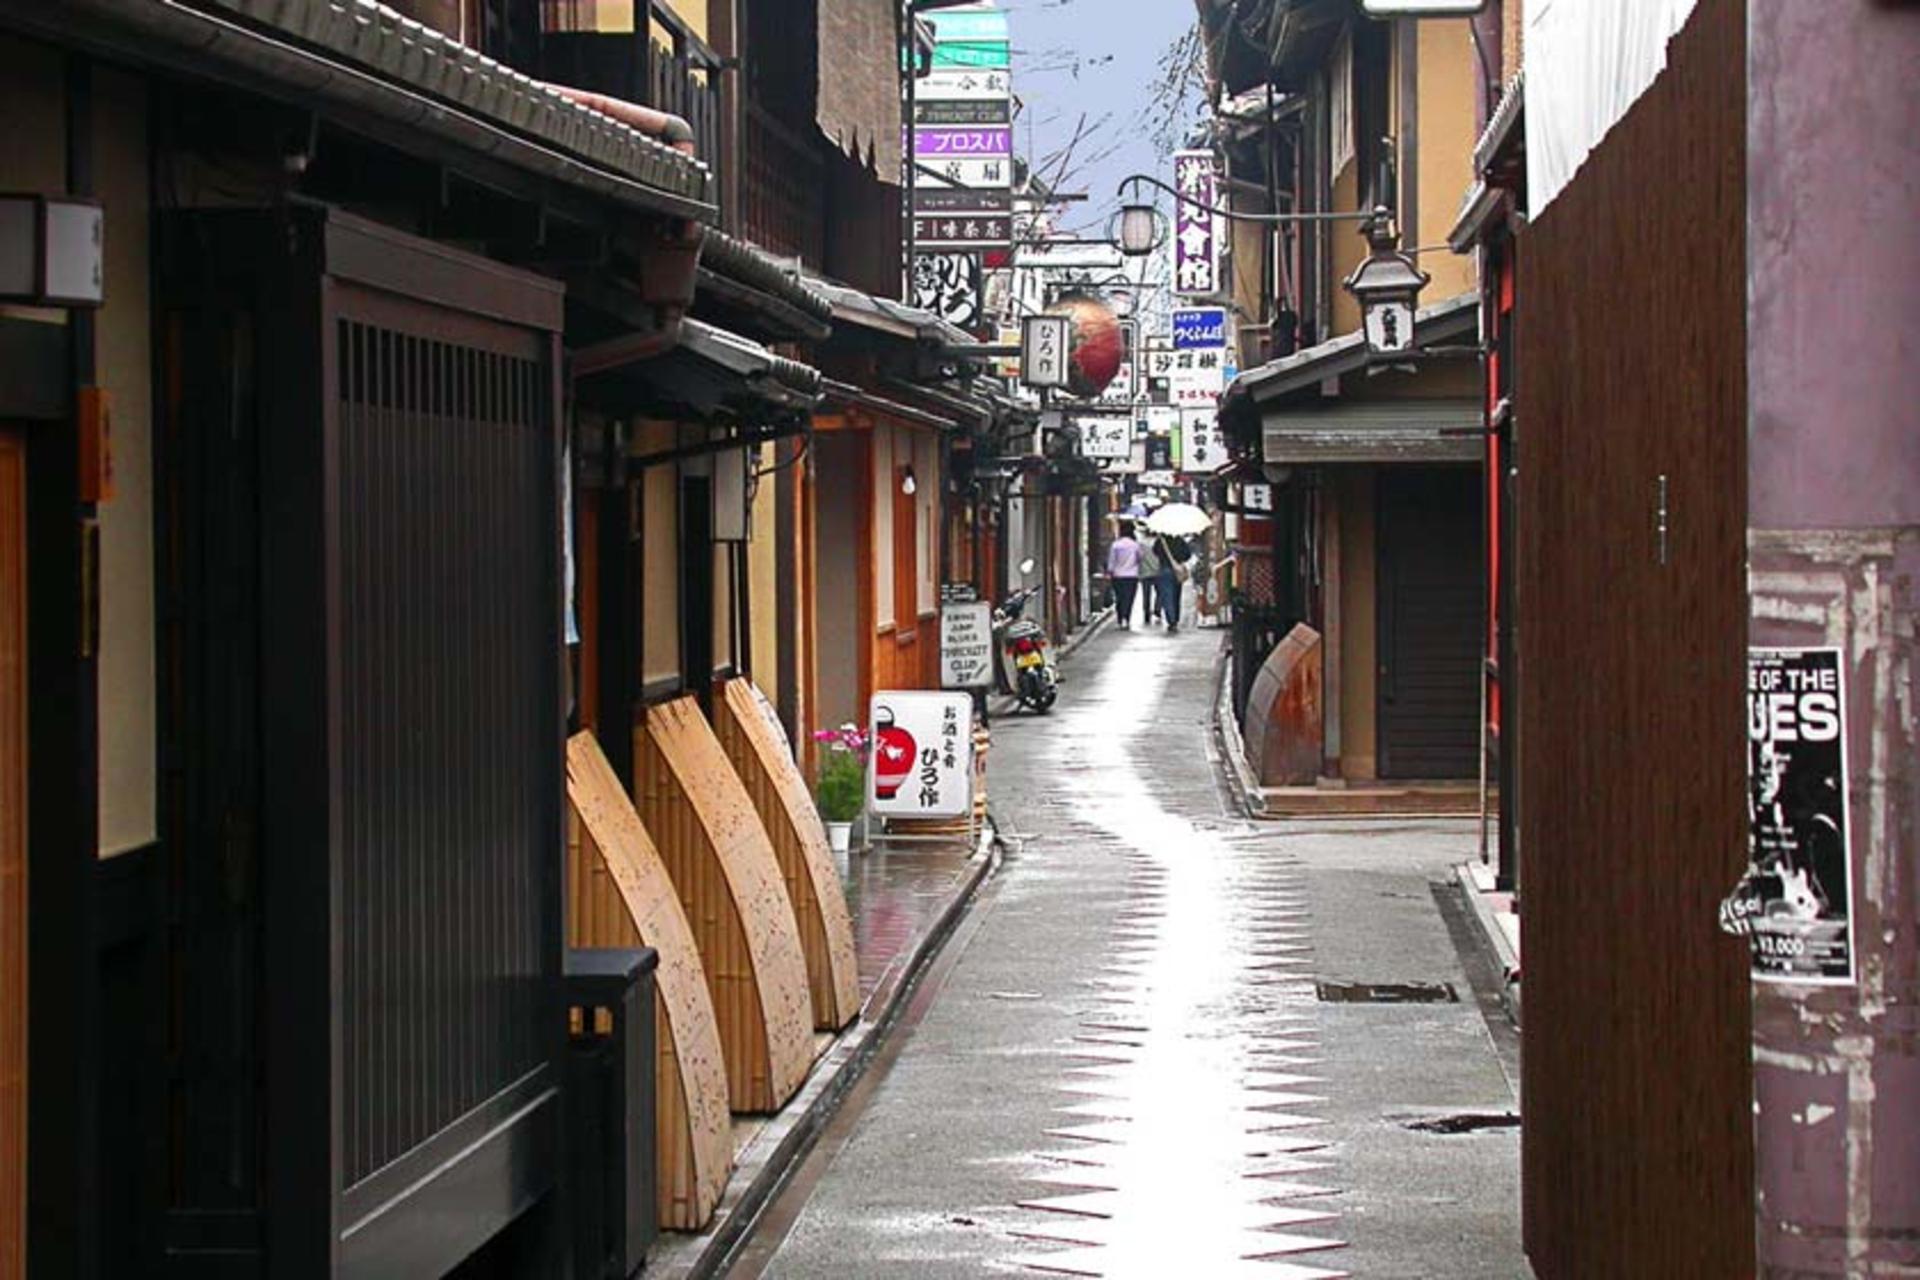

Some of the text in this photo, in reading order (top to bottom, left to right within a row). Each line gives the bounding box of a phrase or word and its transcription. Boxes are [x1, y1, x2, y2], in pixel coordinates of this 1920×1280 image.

[1759, 669, 1781, 690] OF
[1786, 669, 1836, 690] THE
[919, 747, 940, 807] ひろ作
